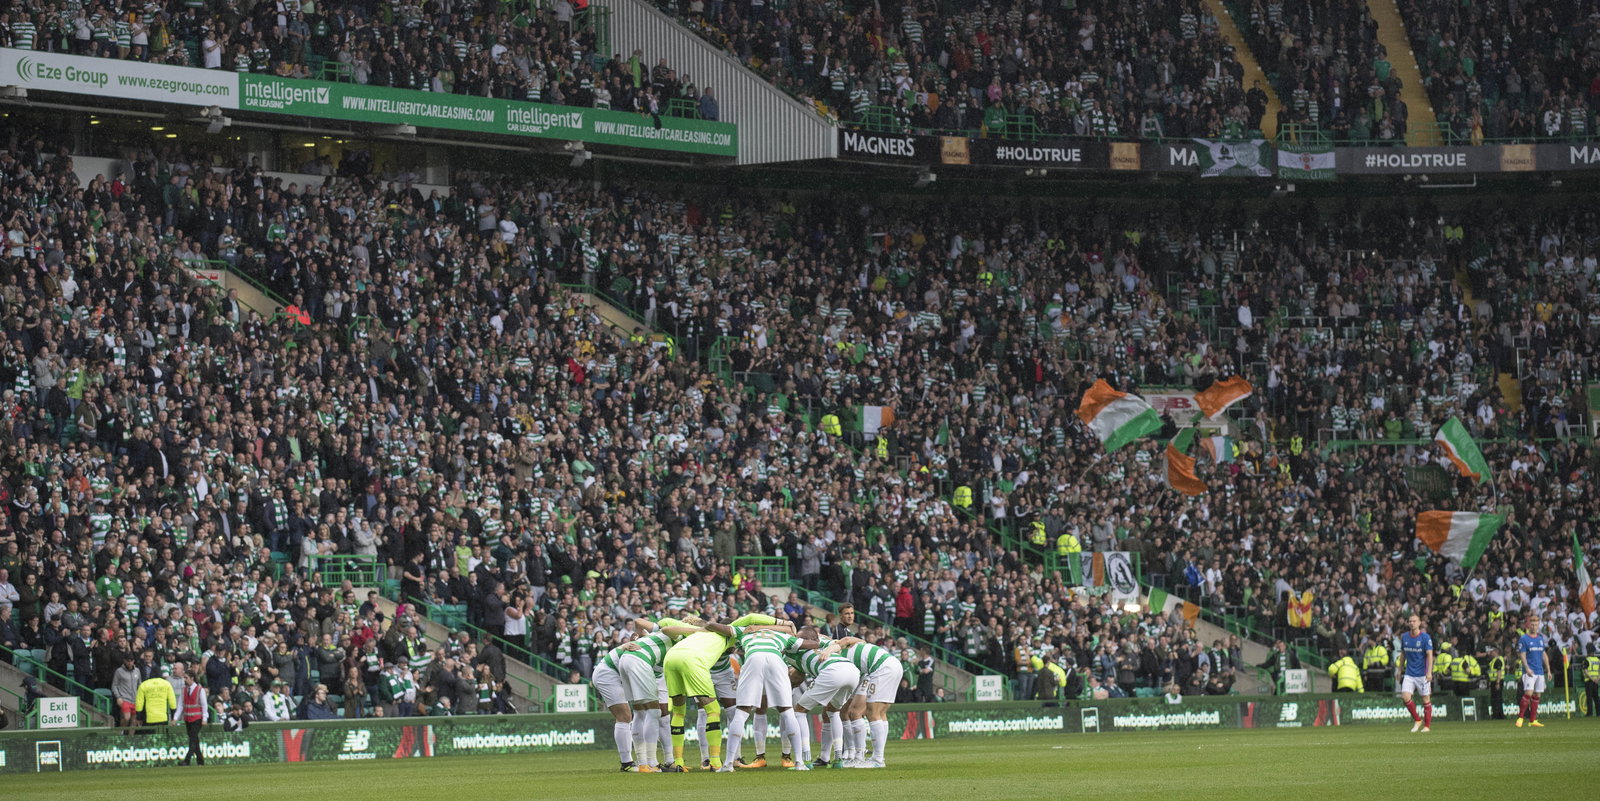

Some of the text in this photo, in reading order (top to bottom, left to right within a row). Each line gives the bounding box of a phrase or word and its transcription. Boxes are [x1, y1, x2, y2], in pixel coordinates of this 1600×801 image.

[36, 63, 109, 88] Eze Group
[118, 74, 230, 96] www.ezegroup.com
[245, 78, 316, 105] intelligent
[245, 98, 284, 109] CAR LEASING
[342, 95, 495, 123] WWW.INTELLIGENTCARLEASING.COM
[507, 104, 571, 130] intelligent
[507, 123, 542, 133] CAR LEASING
[594, 120, 731, 146] WWW.INTELLIGENTCARLEASING.COM
[844, 131, 915, 157] MAGNERS
[996, 145, 1081, 162] #HOLDTRUE
[1365, 153, 1467, 167] #HOLDTRUE
[564, 688, 579, 697] Exit
[50, 702, 68, 711] Exit
[557, 700, 576, 709] Gate
[41, 713, 77, 724] Gate 10
[948, 715, 1064, 732] newbalance.com/football
[452, 729, 595, 749] newbalance.com/football
